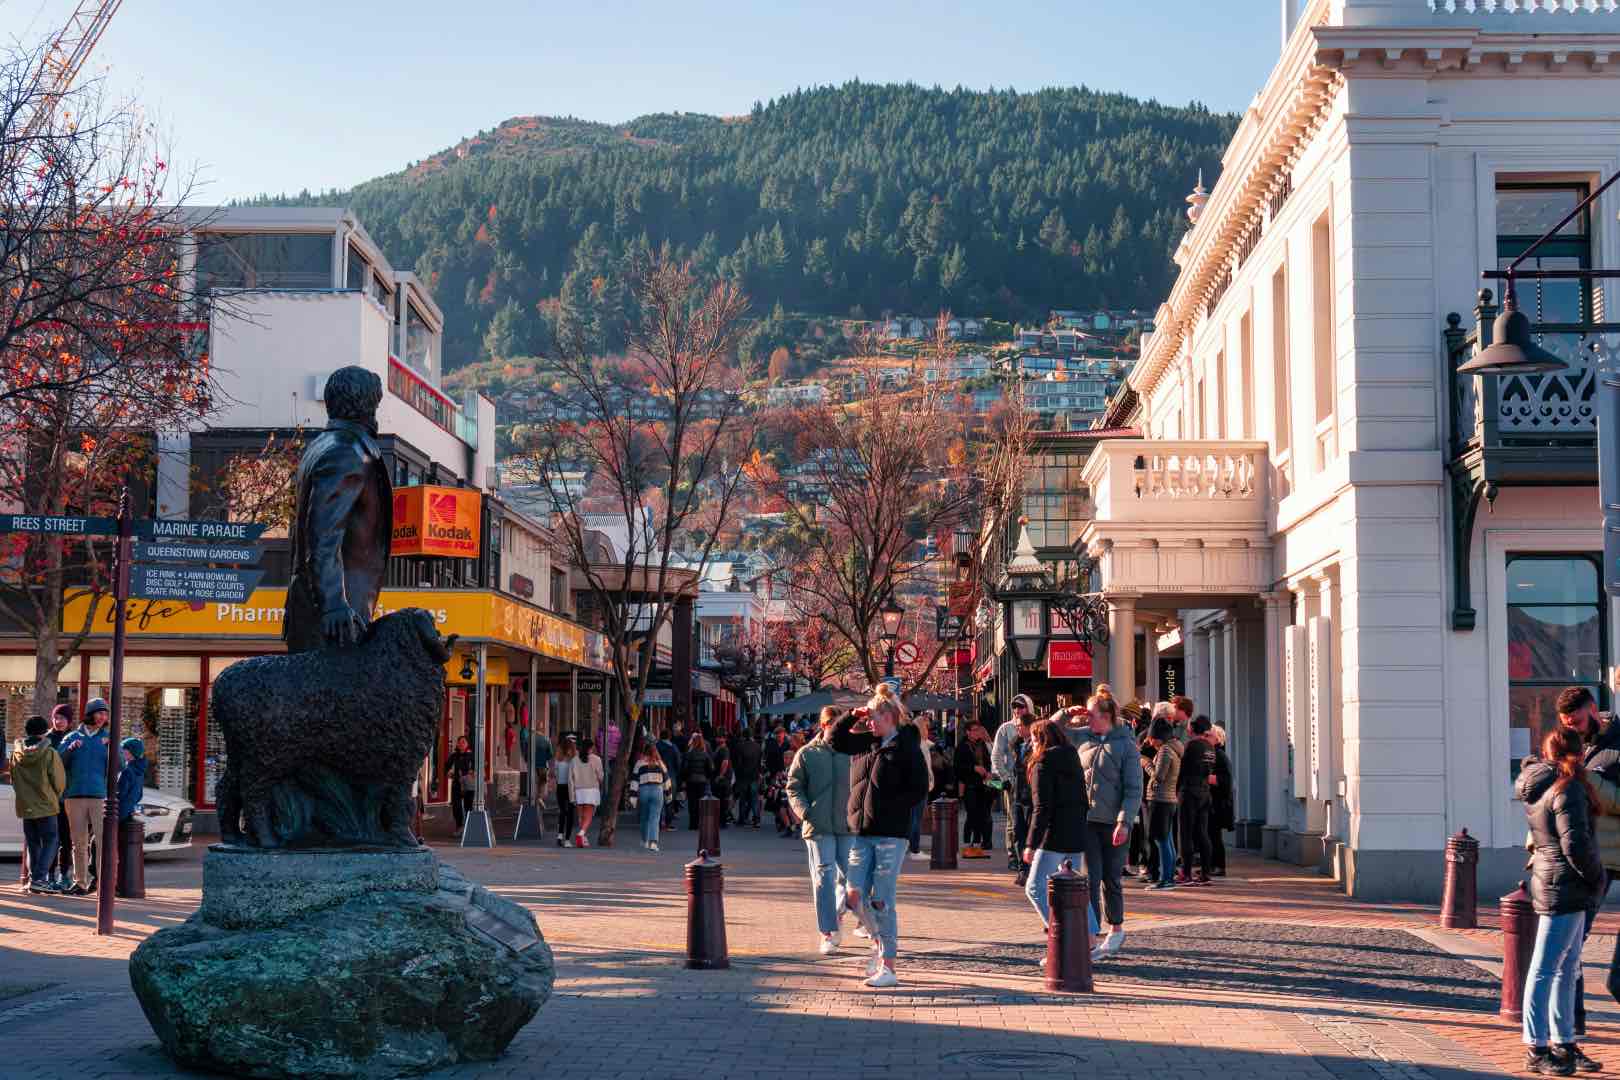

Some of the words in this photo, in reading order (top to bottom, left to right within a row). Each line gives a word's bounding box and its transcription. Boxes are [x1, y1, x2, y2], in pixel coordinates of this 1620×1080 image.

[13, 516, 40, 530] REES
[44, 518, 87, 532] STREET
[153, 521, 199, 536] MARINE
[202, 523, 247, 538] PARADE
[392, 523, 418, 539] odak
[428, 523, 473, 541] Kodak
[147, 546, 207, 558] QUEENSTOWN
[209, 549, 250, 560] GARDENS
[146, 569, 158, 577] ICE
[159, 570, 176, 578] RINK
[183, 571, 204, 580] LAWN
[206, 572, 238, 581] BOWLING
[145, 578, 162, 587] DISC
[164, 579, 183, 588] GOLF
[190, 581, 215, 589] TENNIS
[216, 582, 245, 591] COURTS
[145, 586, 167, 595] SKATE
[168, 587, 187, 597] PARK
[195, 589, 214, 598] ROSE
[215, 590, 244, 599] GARDEN
[217, 603, 286, 623] Pharm
[577, 682, 602, 690] ulture
